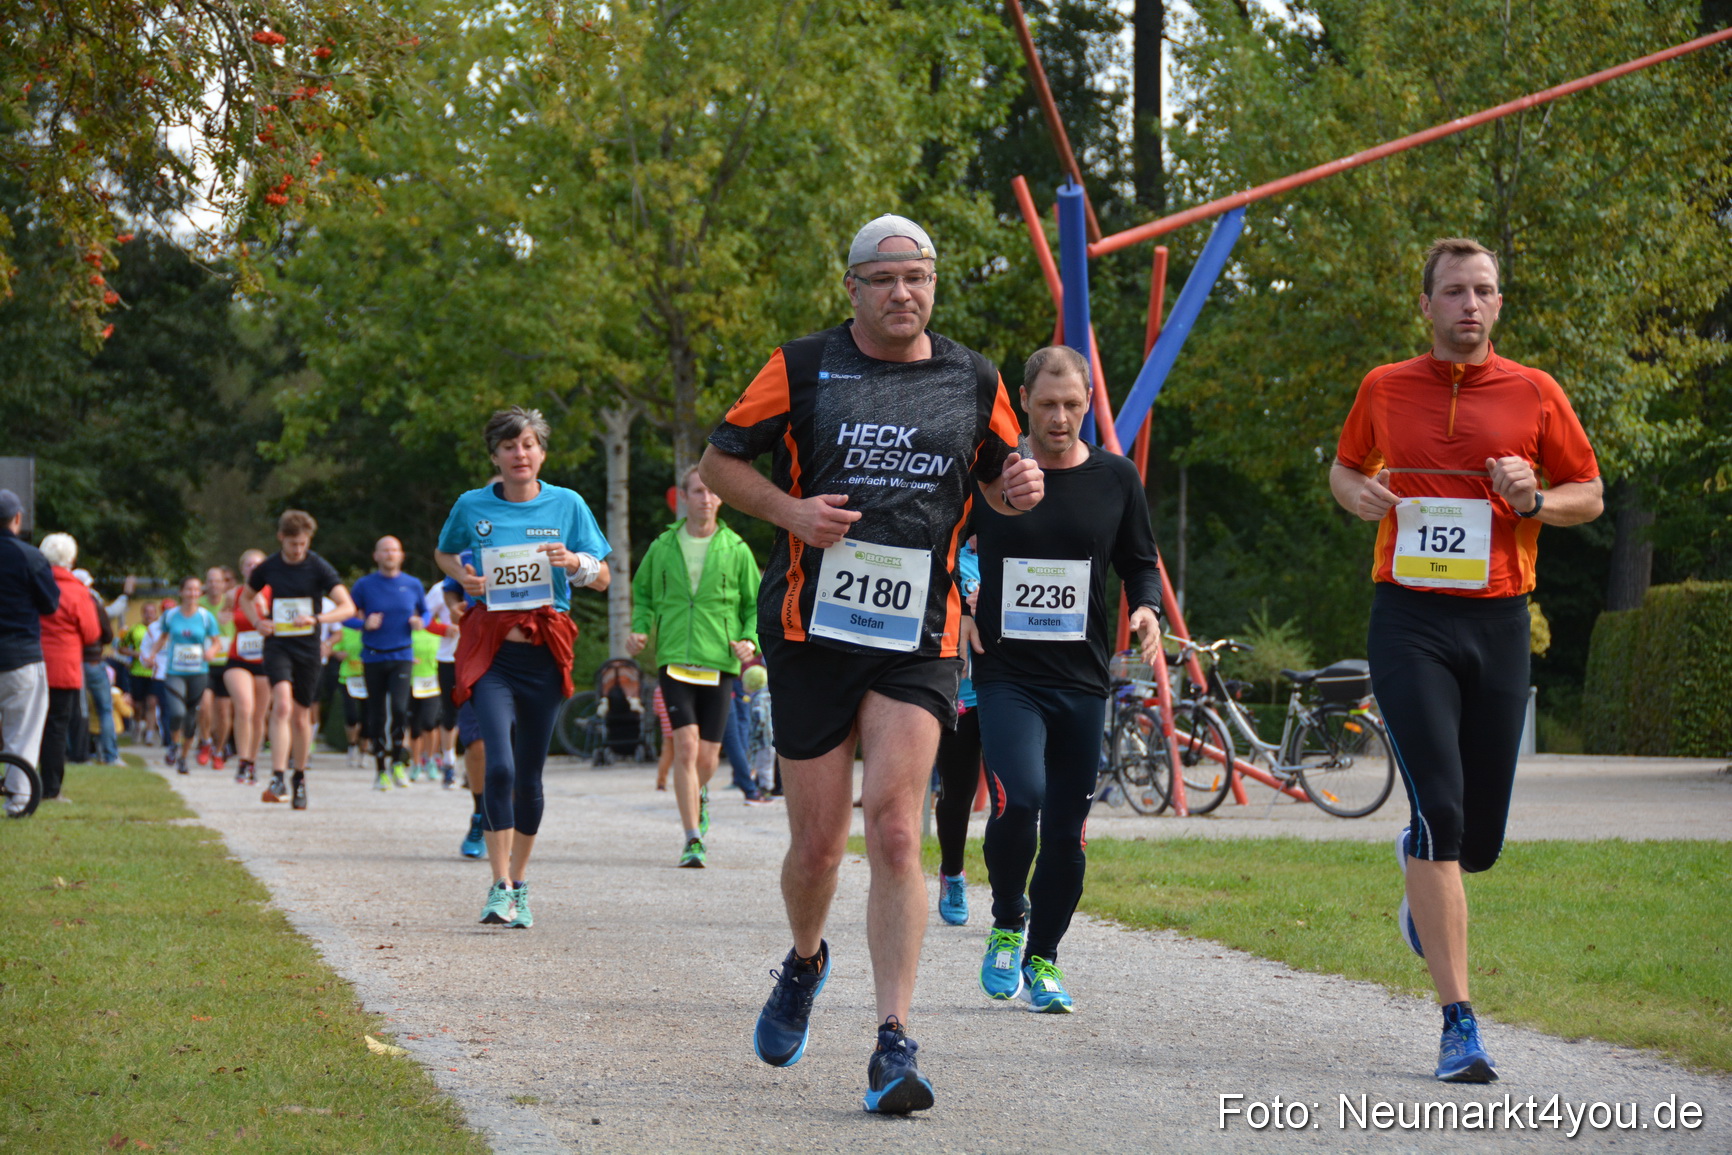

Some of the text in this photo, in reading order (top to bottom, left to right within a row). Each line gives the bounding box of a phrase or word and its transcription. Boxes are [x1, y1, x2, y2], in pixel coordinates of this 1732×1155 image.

[836, 423, 918, 449] HECK
[843, 448, 954, 477] DESIGN
[890, 477, 940, 493] Werbung!
[526, 528, 560, 536] BOCK
[1417, 525, 1466, 553] 152
[865, 552, 902, 566] BOCK
[1429, 562, 1448, 572] Tim
[493, 563, 542, 585] 2552
[510, 589, 530, 599] Birgit
[832, 570, 912, 610] 2180
[1015, 583, 1076, 609] 2236
[850, 613, 885, 630] Stefan
[1028, 616, 1061, 627] Karsten
